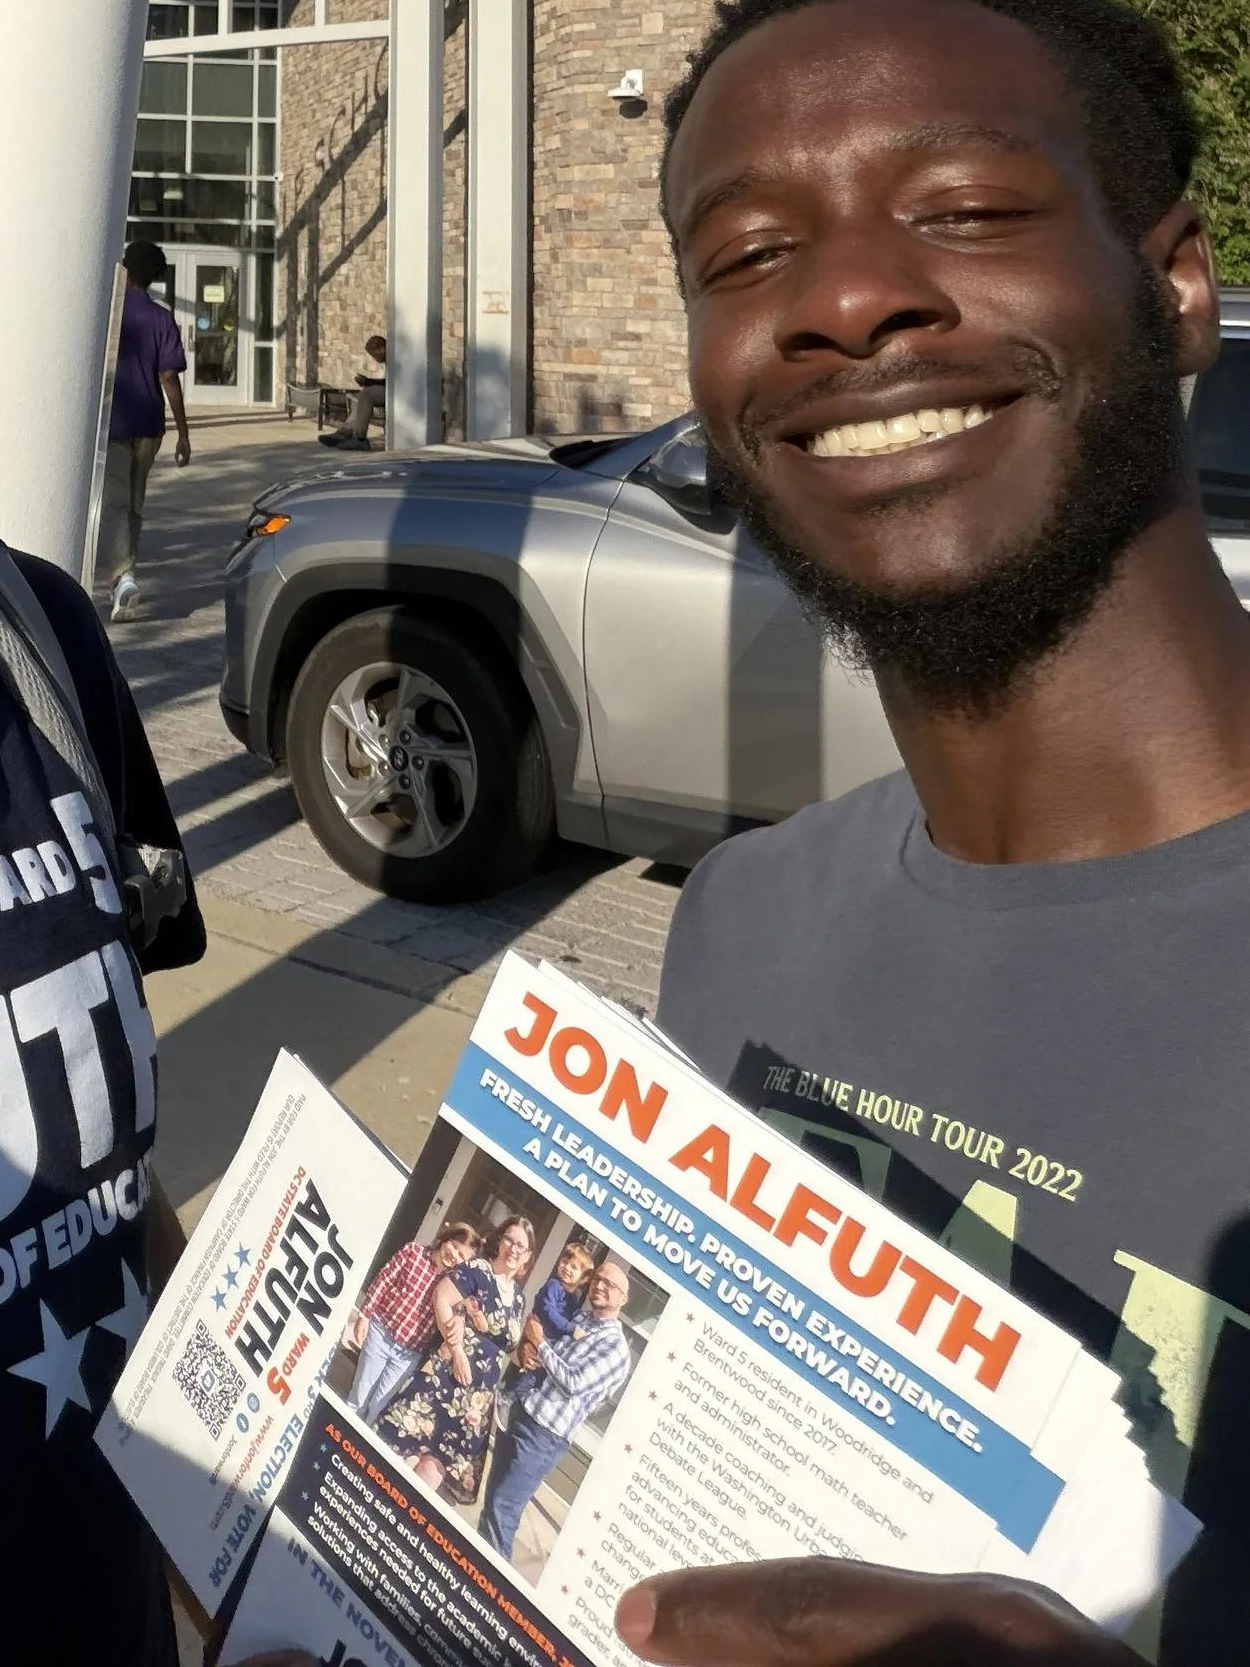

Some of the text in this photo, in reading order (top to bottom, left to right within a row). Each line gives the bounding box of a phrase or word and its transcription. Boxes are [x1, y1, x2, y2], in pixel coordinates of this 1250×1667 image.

[52, 791, 123, 915] 5
[504, 991, 669, 1144] JON
[668, 1124, 1022, 1393] ALFUTH
[762, 1065, 1085, 1202] THE BLUE HOUR TOUR 2022
[41, 1146, 153, 1270] EDUCA
[224, 1165, 307, 1339] DC STATE BOARD OF EDUCATION
[479, 1068, 983, 1453] FRESH LEADERSHIP. PROVEN EXPERIENCE.
[234, 1178, 339, 1378] ALFUTH
[282, 1223, 354, 1337] JON
[521, 1131, 896, 1426] A PLAN TO MOVE US FORWARD.
[266, 1366, 292, 1406] 5
[282, 1332, 311, 1377] WARD
[693, 1338, 838, 1452] Brentwood since 2017.
[702, 1321, 935, 1504] Ward 5 resident in Woodridge and
[649, 1431, 747, 1520] Debate League.
[657, 1417, 791, 1532] with the Washington
[662, 1402, 674, 1416] A
[675, 1412, 724, 1455] decade
[724, 1451, 787, 1507] coaching
[787, 1502, 818, 1529] and
[674, 1379, 791, 1473] and administrator.
[682, 1361, 908, 1541] Former high school math teacher
[204, 1410, 306, 1589] ELECTION, VOTE FOR
[307, 1515, 353, 1567] solutions
[352, 1562, 374, 1590] that
[324, 1471, 378, 1534] Expanding
[377, 1529, 414, 1570] access
[413, 1565, 426, 1583] to
[427, 1578, 447, 1604] the
[325, 1423, 342, 1443] AS
[342, 1439, 367, 1469] OUR
[366, 1463, 408, 1509] BOARD
[408, 1506, 427, 1526] OF
[426, 1523, 498, 1599] EDUCATION
[497, 1593, 557, 1662] MEMBER,
[331, 1454, 381, 1510] Creating
[379, 1504, 397, 1526] safe
[396, 1522, 420, 1548] and
[418, 1542, 461, 1590] healthy
[460, 1584, 509, 1641] learning
[508, 1636, 543, 1667] envir
[607, 1521, 657, 1570] Regular
[618, 1502, 669, 1550] national
[625, 1484, 643, 1505] for
[642, 1502, 707, 1563] students
[628, 1471, 698, 1533] advancing
[638, 1453, 683, 1498] Fifteen
[681, 1493, 719, 1528] years
[718, 1524, 765, 1568] profes
[287, 1540, 309, 1567] IN
[310, 1559, 346, 1608] THE
[346, 1602, 400, 1667] NOVE
[314, 1501, 421, 1623] Working with families,
[319, 1485, 379, 1552] experiences
[379, 1548, 421, 1595] needed
[419, 1589, 437, 1611] for
[436, 1607, 472, 1648] future
[581, 1573, 598, 1593] a
[594, 1583, 616, 1609] DC
